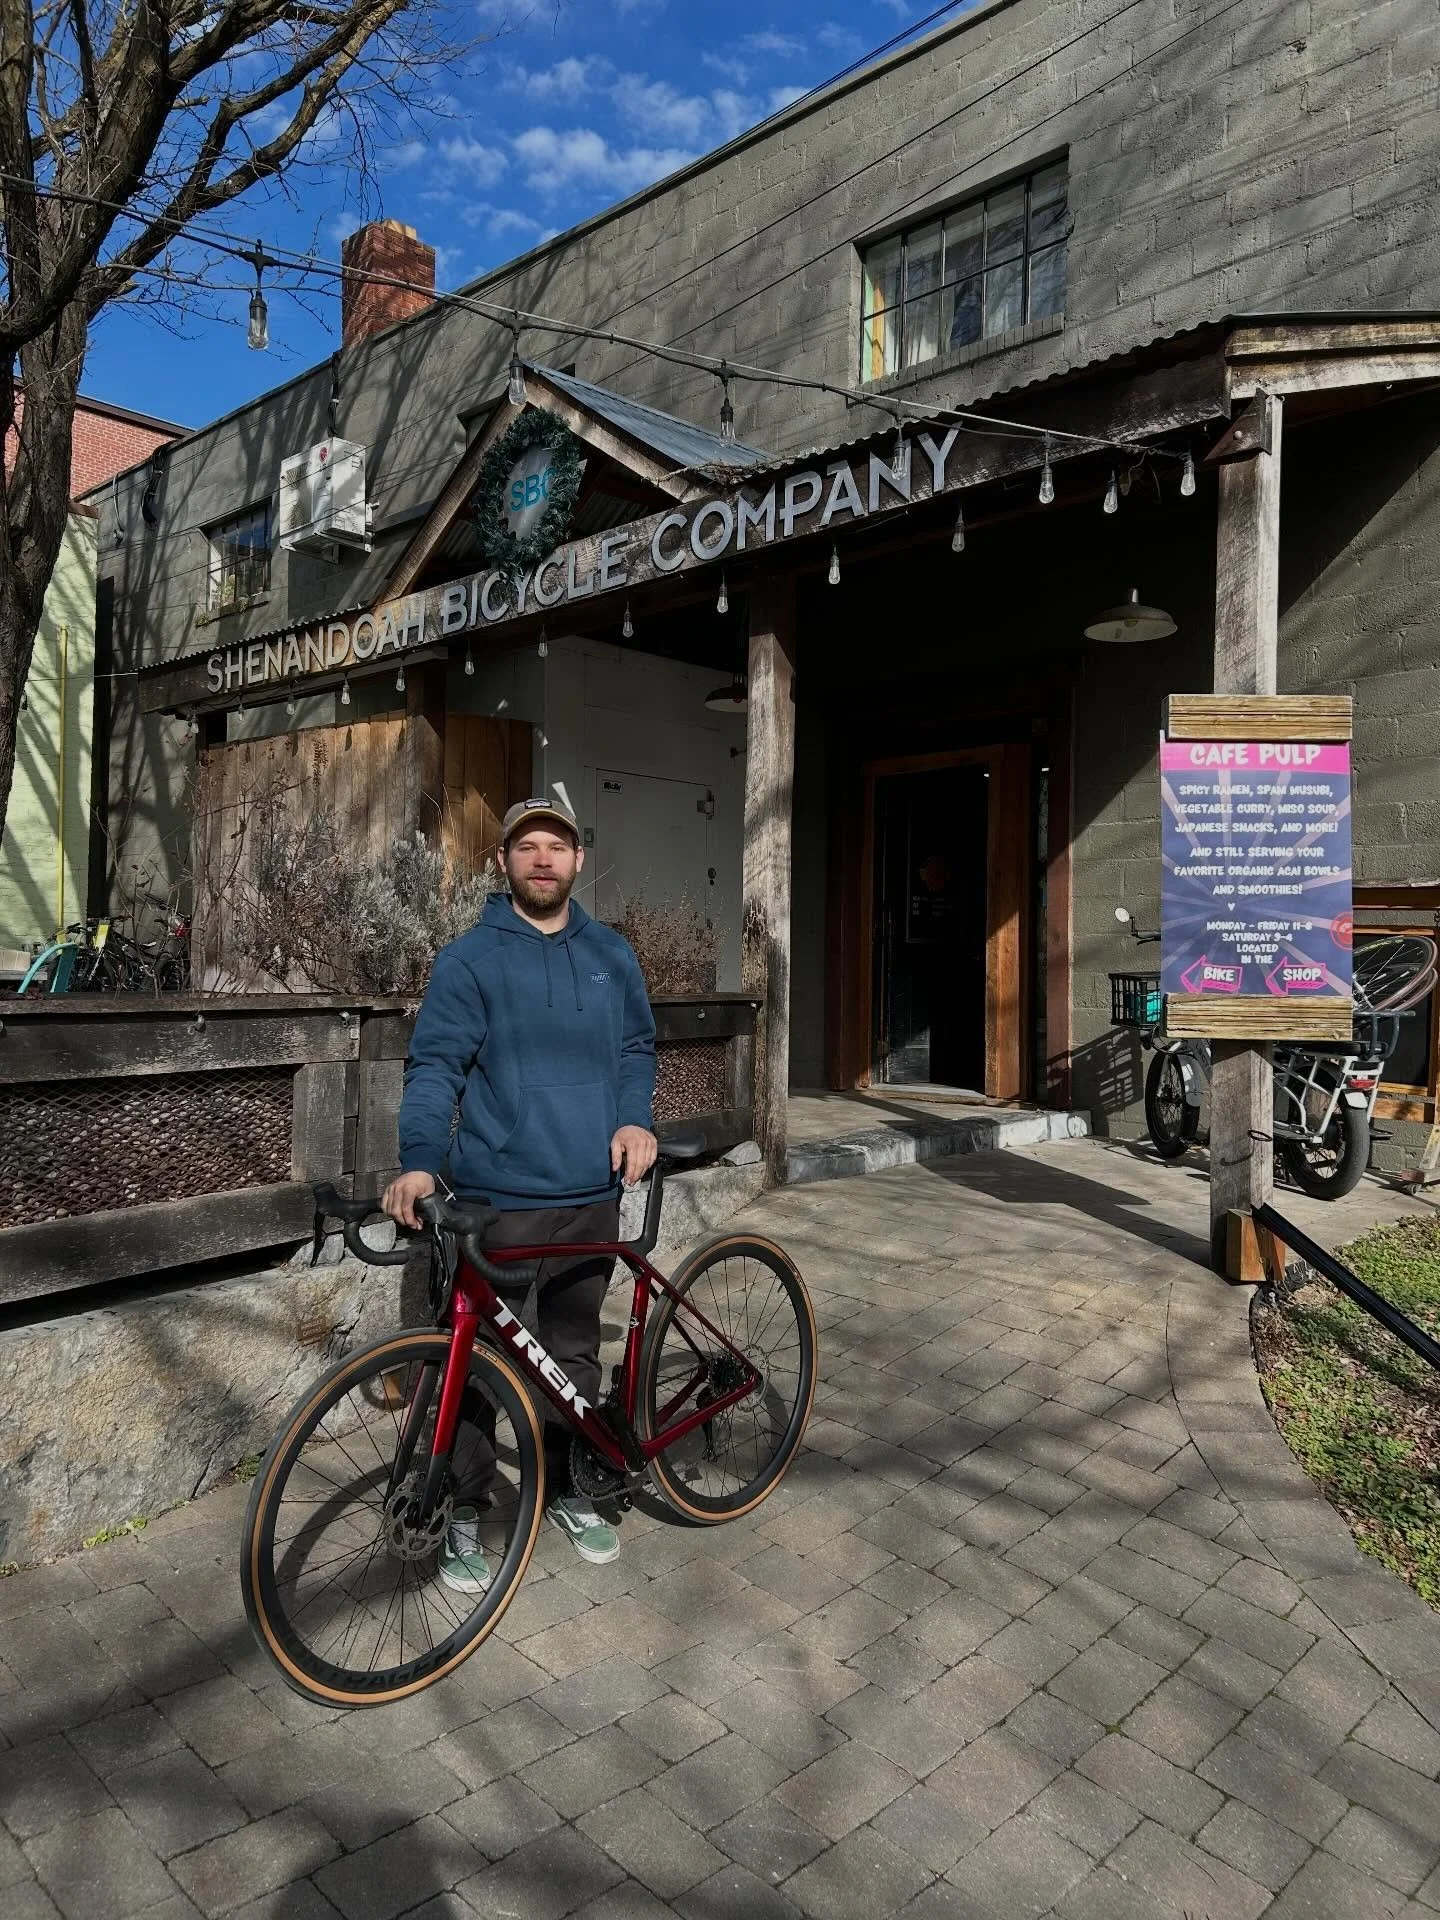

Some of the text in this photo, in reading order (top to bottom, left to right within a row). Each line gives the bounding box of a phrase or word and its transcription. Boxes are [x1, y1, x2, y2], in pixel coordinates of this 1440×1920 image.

[206, 420, 963, 694] SHENANDOAH BICYCLE COMPANY
[1190, 743, 1321, 766] CAFE PULP
[1179, 785, 1333, 797] SPICY RAMEN, SPAM MUSUBI,
[1175, 803, 1339, 815] VEGETABLE CURRY, MISO SOUP,
[1175, 822, 1338, 834] JAPANESE SNACKS, AND MORE!
[1190, 847, 1324, 857] AND STILL SERVING YOUR
[1174, 866, 1340, 876] FAVORITE ORGANIC ACAI BOWLS
[1213, 885, 1303, 895] AND SMOOTHIES!
[1206, 921, 1246, 931] MONDAY
[1257, 921, 1290, 931] FRIDAY
[1222, 933, 1271, 942] SATURDAY
[1236, 944, 1279, 953] LOCATED
[1241, 955, 1273, 964] IN THE
[1203, 967, 1236, 982] BIKE
[1282, 968, 1322, 981] SHOP
[493, 1296, 593, 1420] TREK
